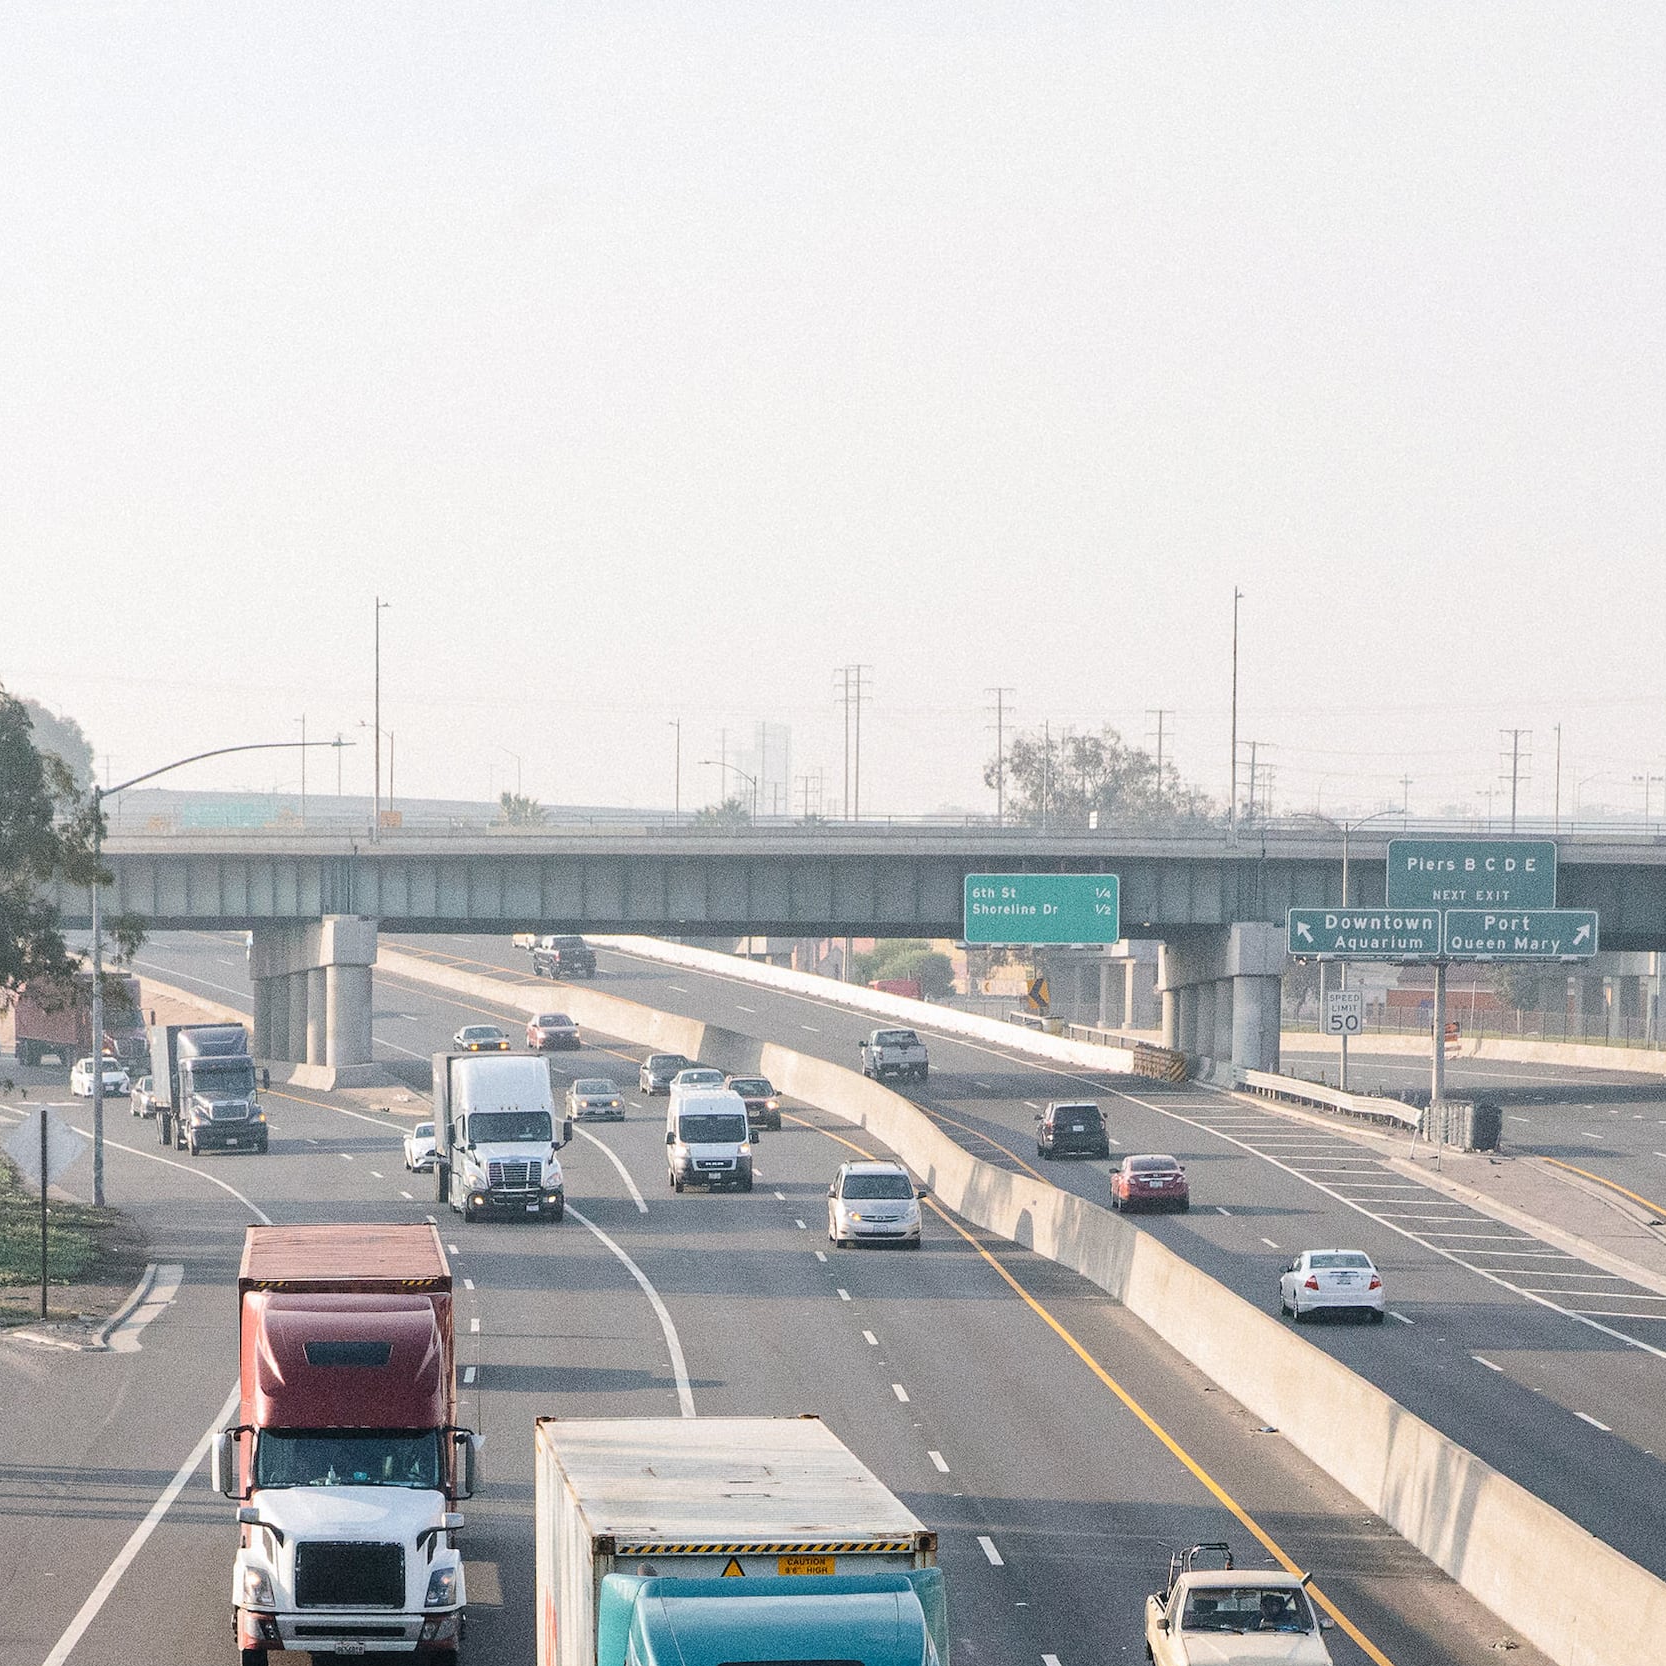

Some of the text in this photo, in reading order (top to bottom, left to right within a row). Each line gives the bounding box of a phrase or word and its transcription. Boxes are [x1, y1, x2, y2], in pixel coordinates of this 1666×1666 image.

[1407, 858, 1536, 871] Piers B C D E
[972, 887, 995, 898] 6th
[1001, 887, 1016, 898] St
[1433, 890, 1510, 901] NEXT EXIT
[972, 903, 1036, 915] Shoreline
[1043, 904, 1058, 915] Dr
[1325, 914, 1433, 930] Downtown
[1484, 915, 1530, 931] Port
[1335, 936, 1423, 951] Aquarium
[1451, 936, 1560, 954] Queen Mary
[1331, 1014, 1358, 1031] 50
[787, 1557, 826, 1565] CAUTION
